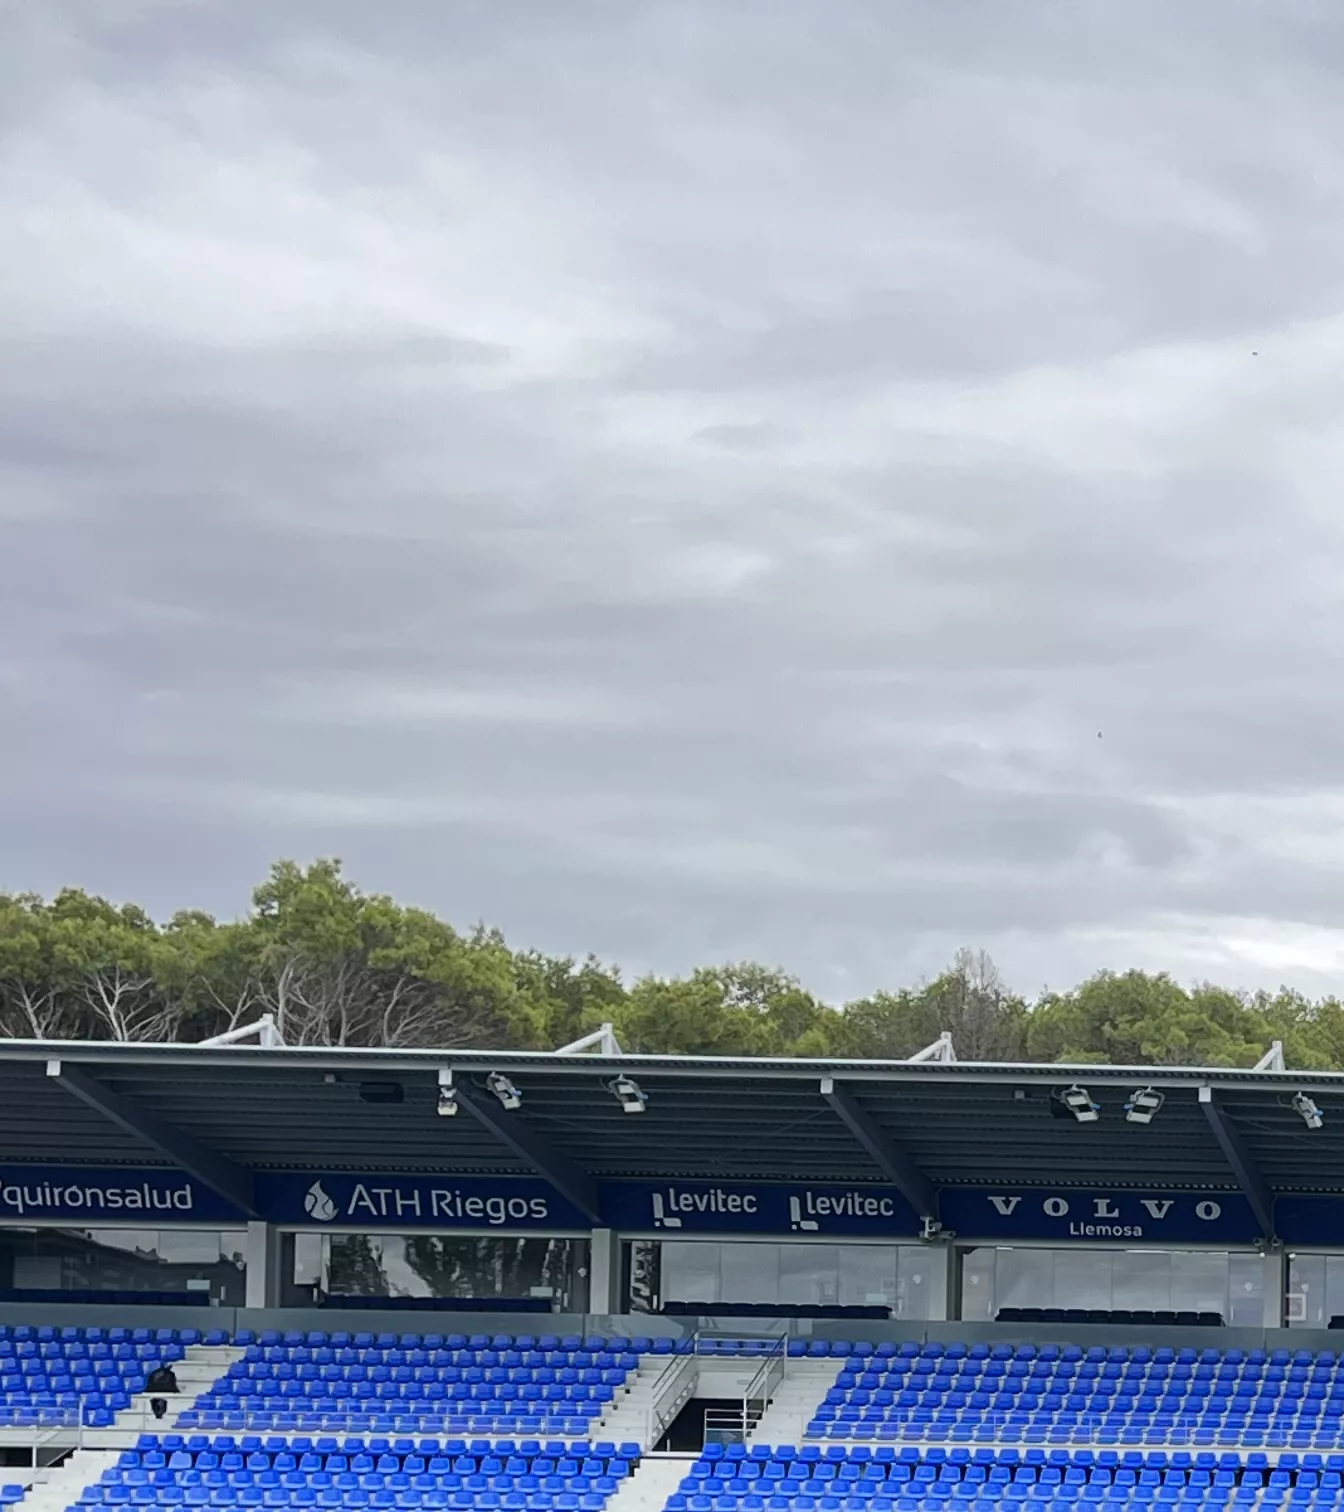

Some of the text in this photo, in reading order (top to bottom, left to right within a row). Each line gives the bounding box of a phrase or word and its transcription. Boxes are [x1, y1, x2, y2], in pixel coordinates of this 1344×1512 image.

[348, 1184, 547, 1225] ATH Riegos
[1070, 1221, 1143, 1238] Llemosa
